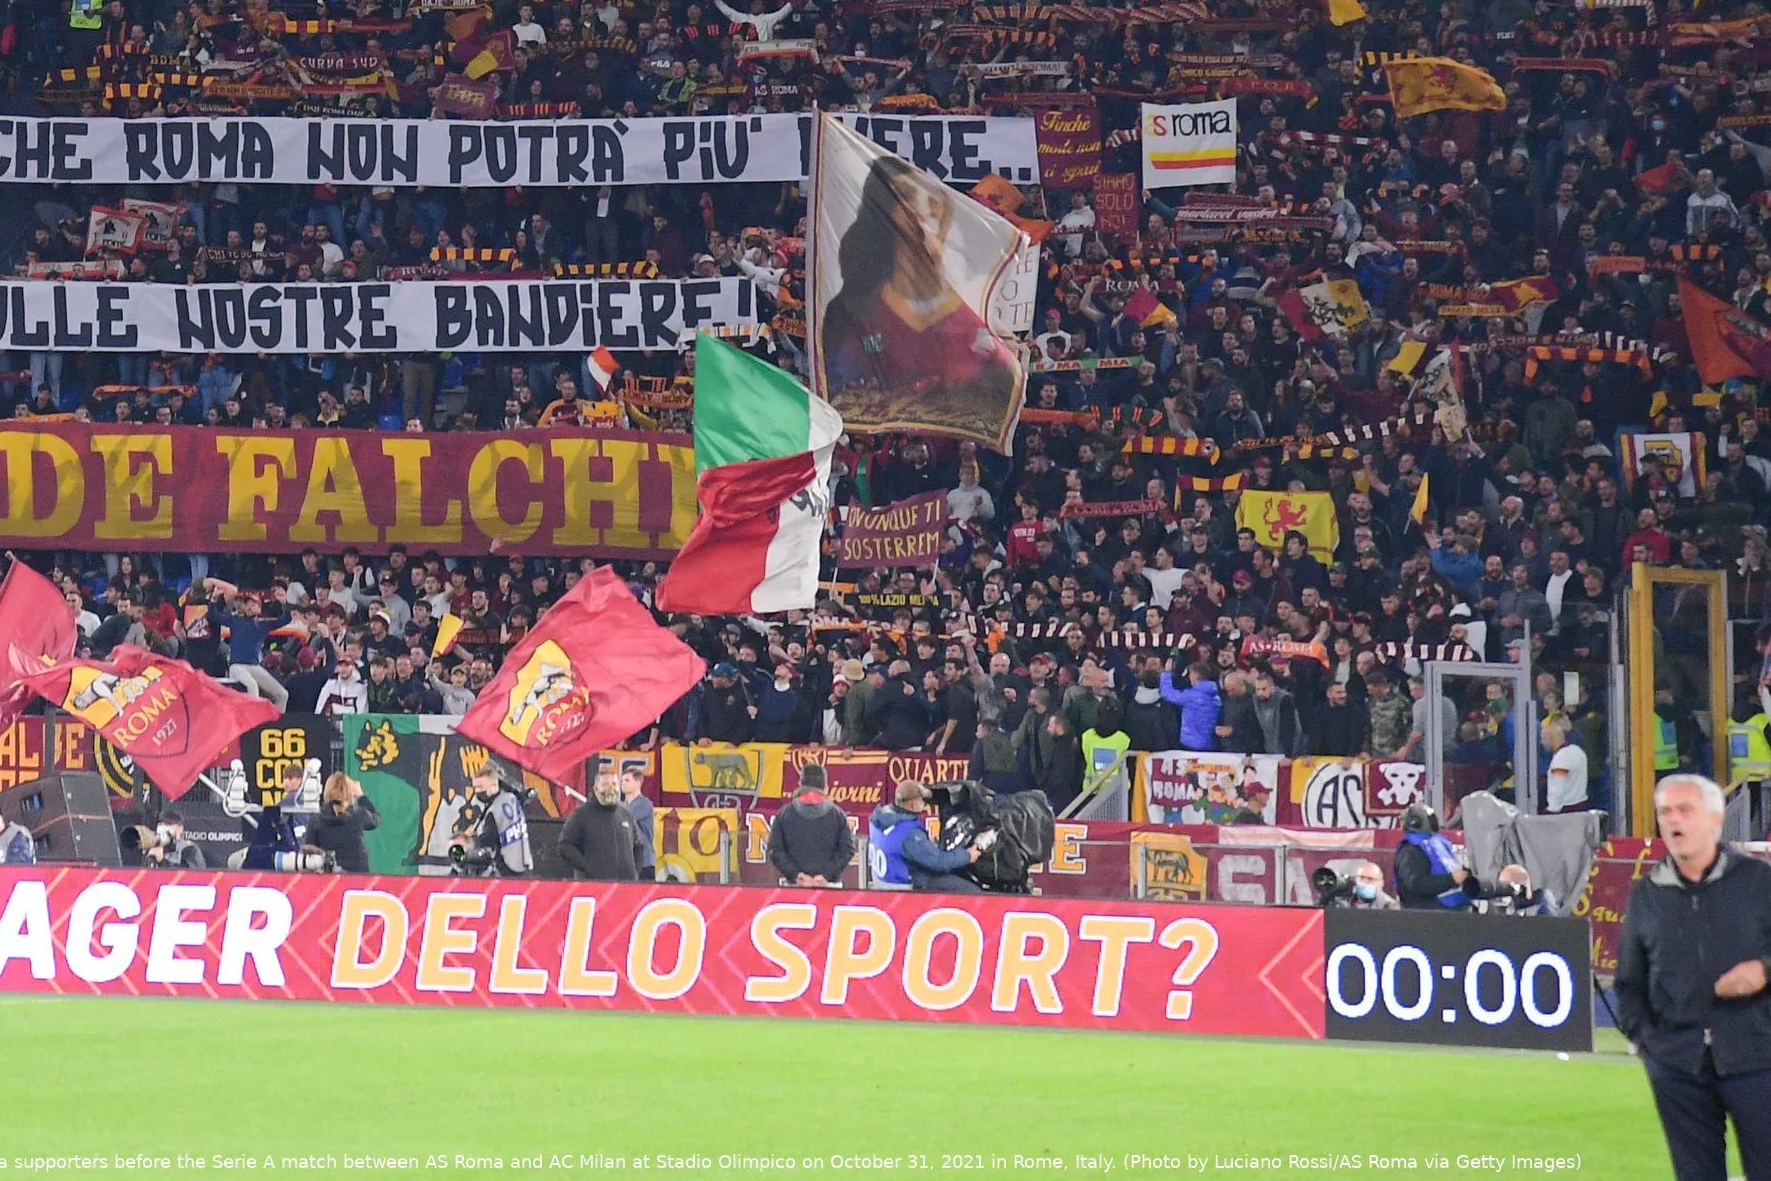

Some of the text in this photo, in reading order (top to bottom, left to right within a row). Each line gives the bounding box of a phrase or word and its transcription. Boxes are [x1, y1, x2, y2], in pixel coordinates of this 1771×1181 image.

[300, 56, 379, 70] CURVA SUD
[771, 83, 799, 95] ROMA
[1172, 110, 1232, 137] roma
[127, 123, 275, 181] ROMA
[307, 126, 419, 184] NON
[1092, 173, 1136, 190] SIAMO
[1095, 193, 1135, 211] SOLO
[176, 285, 397, 351] NOSTRE
[1099, 359, 1129, 368] MIA
[847, 499, 942, 532] OVUNQUE TI
[880, 594, 906, 606] LAZIO
[910, 595, 939, 607] MEA
[113, 686, 178, 749] ROMA
[535, 687, 591, 747] ROMA
[151, 718, 178, 746] 1927
[260, 728, 306, 758] 66
[329, 889, 708, 1001] DELLO
[744, 902, 1220, 1021] SPORT?
[1325, 942, 1574, 1028] 00:00
